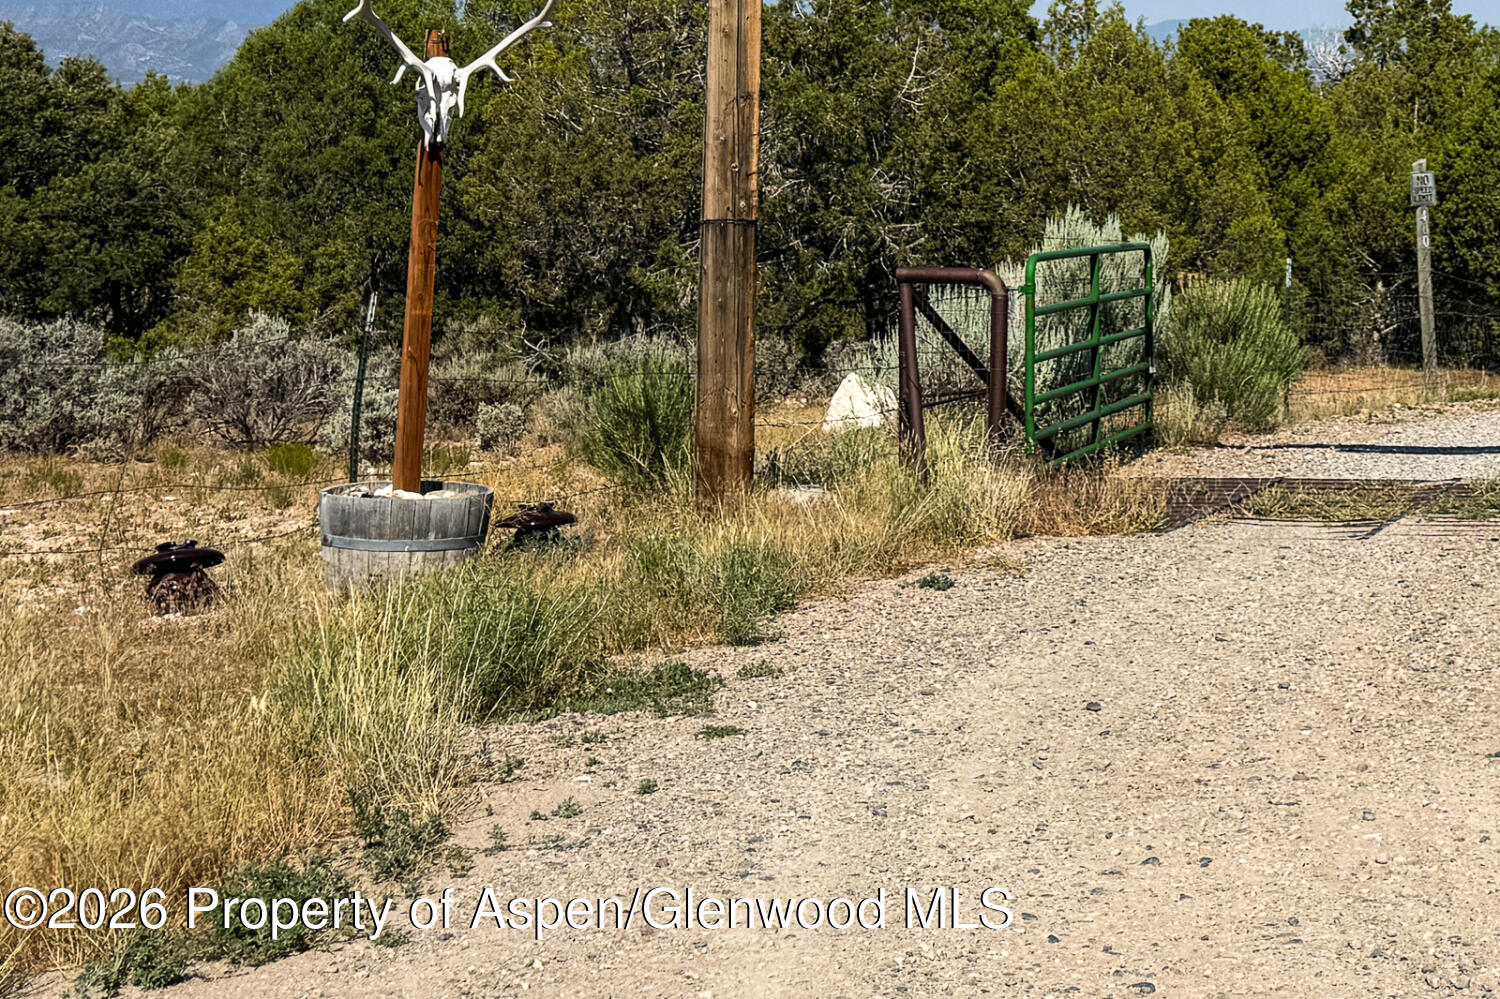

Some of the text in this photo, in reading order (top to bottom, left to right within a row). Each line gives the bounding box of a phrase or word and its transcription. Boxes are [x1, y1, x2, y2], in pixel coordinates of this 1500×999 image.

[1416, 174, 1429, 186] NO
[1413, 186, 1433, 194] SPEED
[1412, 194, 1433, 202] LIMIT
